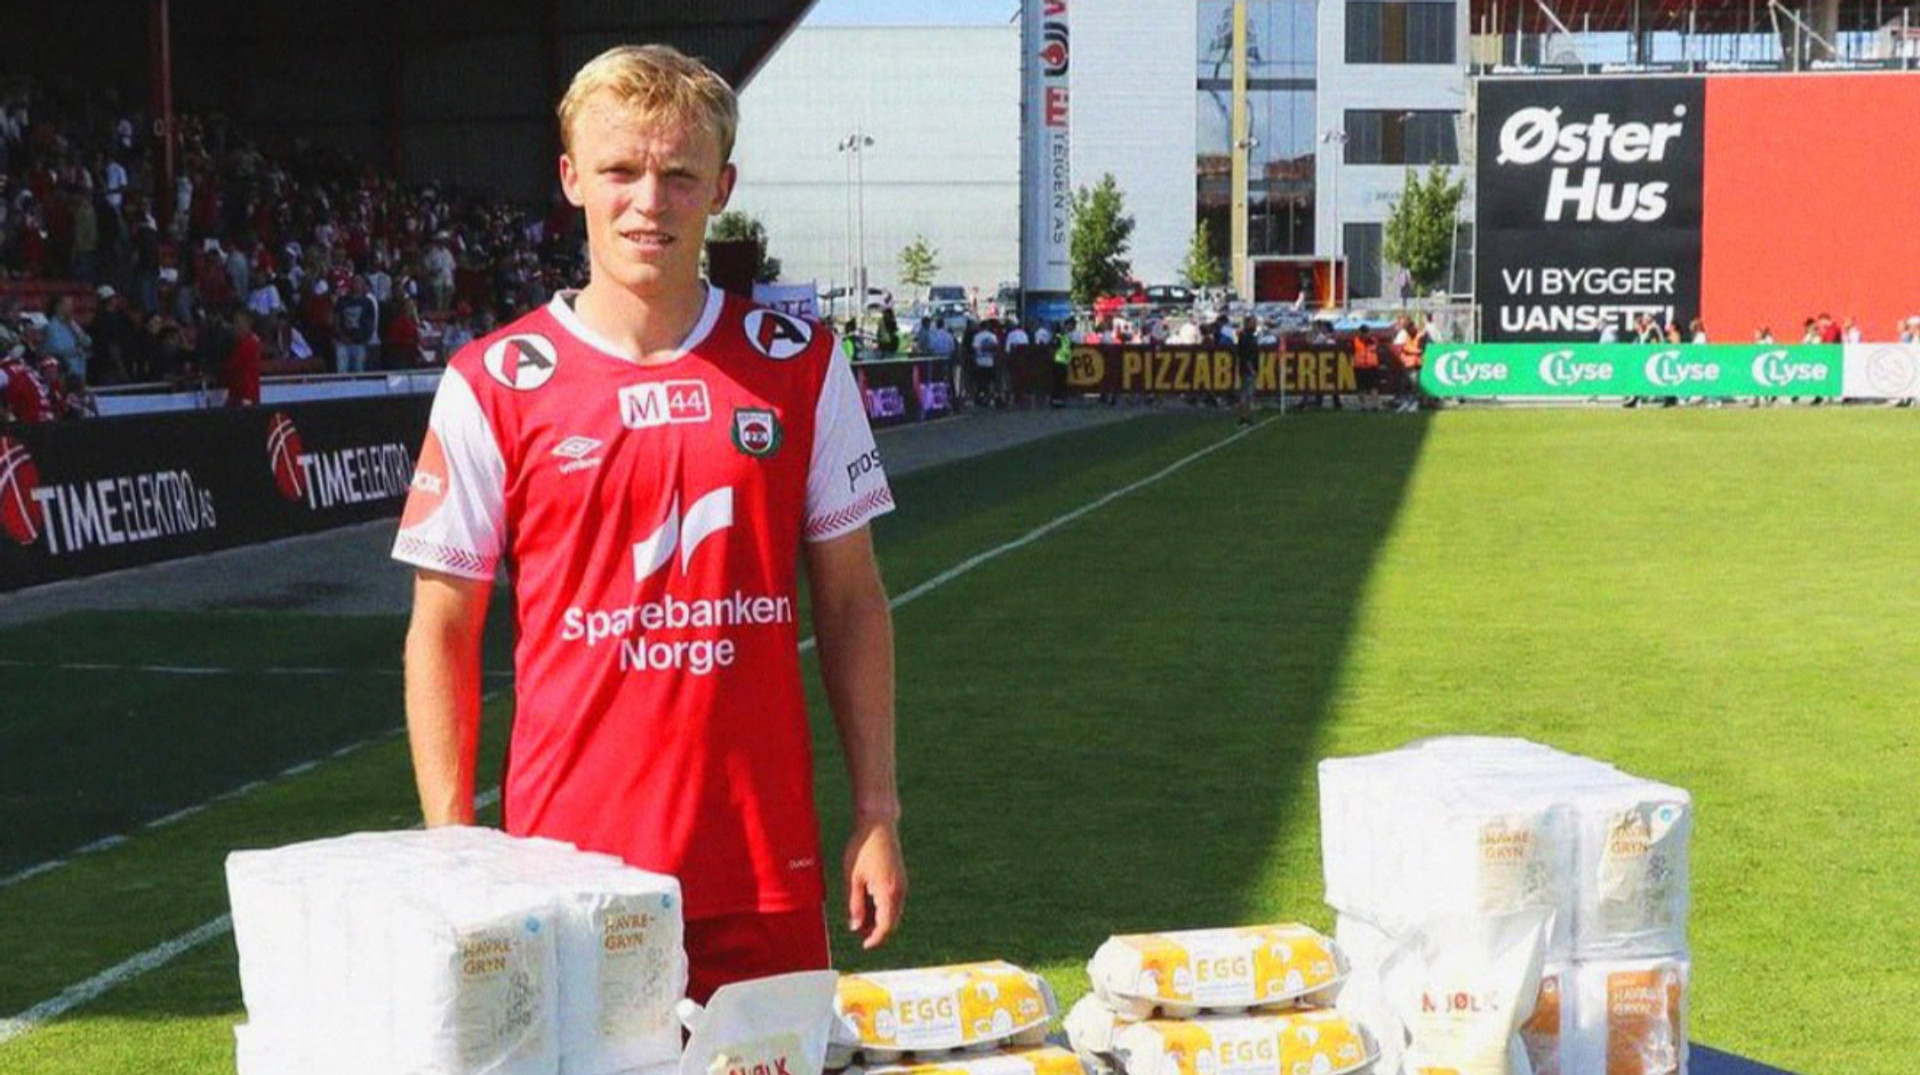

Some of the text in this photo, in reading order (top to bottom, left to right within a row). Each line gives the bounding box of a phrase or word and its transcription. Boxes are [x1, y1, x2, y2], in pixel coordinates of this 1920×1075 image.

[1497, 104, 1687, 165] Øster
[1053, 133, 1065, 209] TEIGEN
[1544, 168, 1670, 222] Hus
[1053, 216, 1065, 244] AS
[1502, 268, 1676, 295] VI BYGGER
[1122, 351, 1357, 390] PIZZABKEREN
[1451, 357, 1509, 386] Lyse
[1555, 357, 1614, 386] Lyse
[1662, 357, 1721, 386] Lyse
[1769, 357, 1829, 386] Lyse
[562, 590, 792, 646] Sparebanken
[619, 636, 736, 676] Norge
[1195, 956, 1248, 982] EGG
[900, 996, 953, 1024] EGG
[1218, 1040, 1273, 1065] EGG
